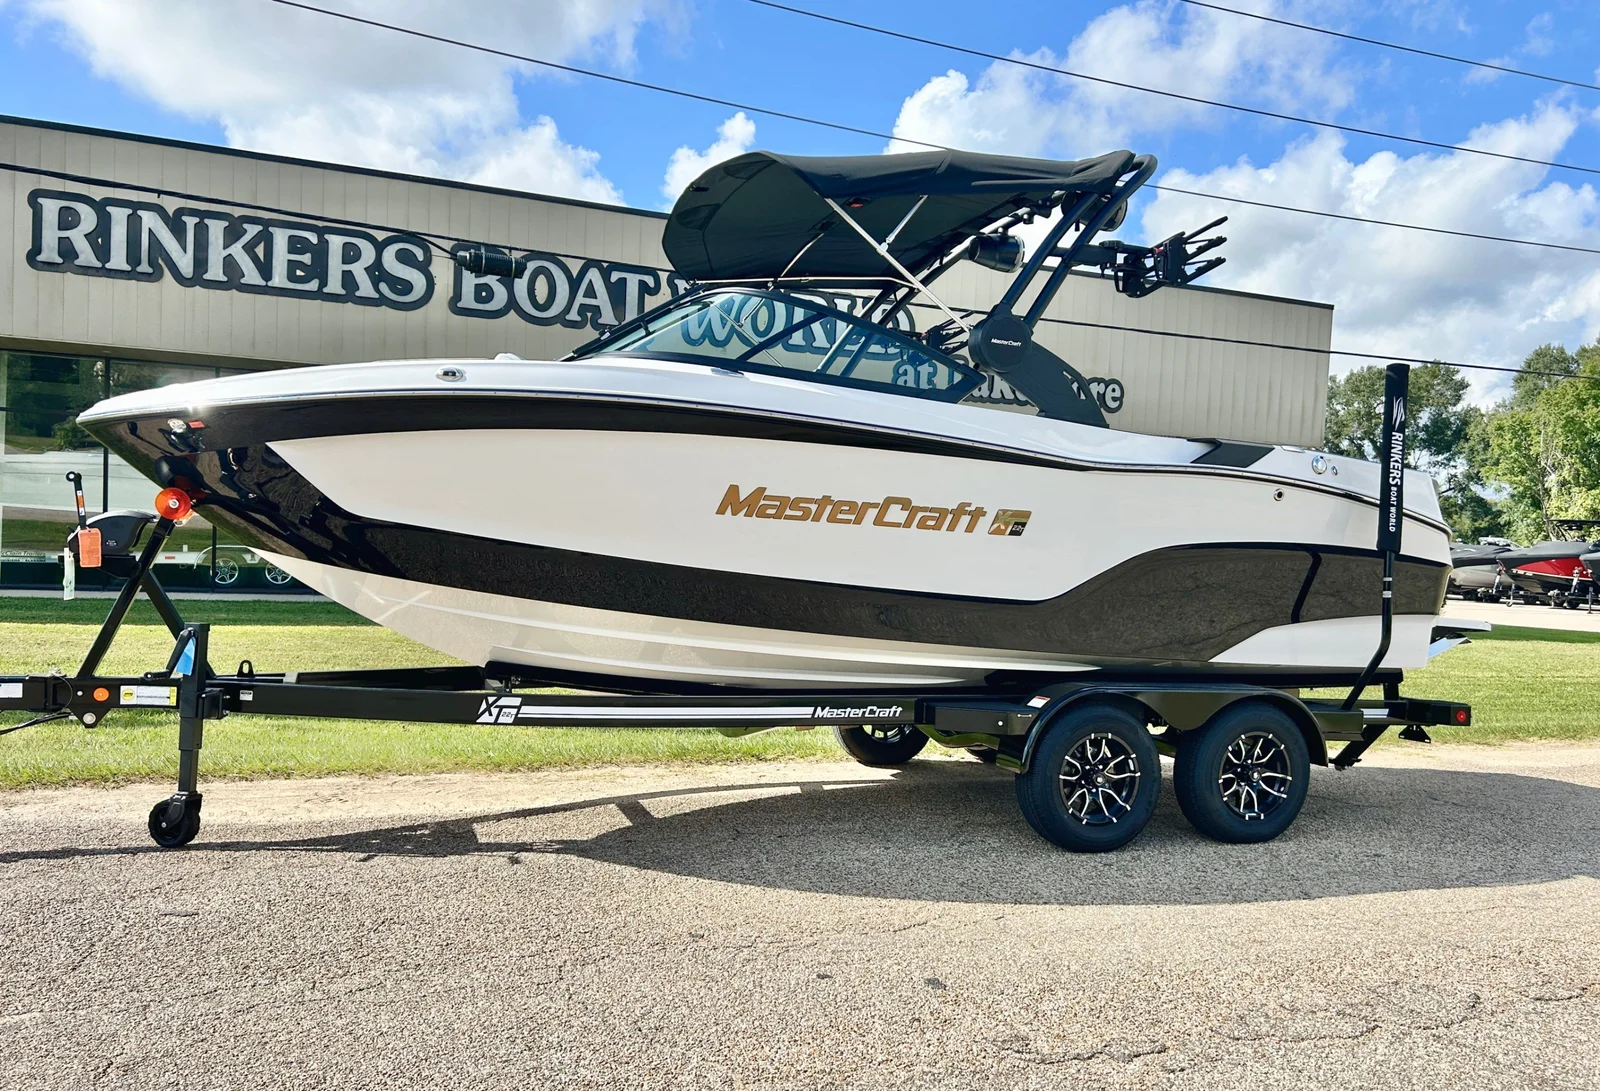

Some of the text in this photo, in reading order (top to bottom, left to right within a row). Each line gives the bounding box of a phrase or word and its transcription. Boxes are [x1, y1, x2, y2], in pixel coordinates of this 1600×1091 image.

[35, 196, 428, 303] RINKERS
[456, 244, 656, 326] BOAT
[991, 338, 1022, 347] MasterCraft
[898, 362, 934, 390] at
[1389, 431, 1403, 485] RINKERS
[715, 484, 988, 533] MasterCraft
[1389, 506, 1397, 532] WORLD
[476, 696, 521, 723] XT
[814, 701, 903, 718] MasterCraft
